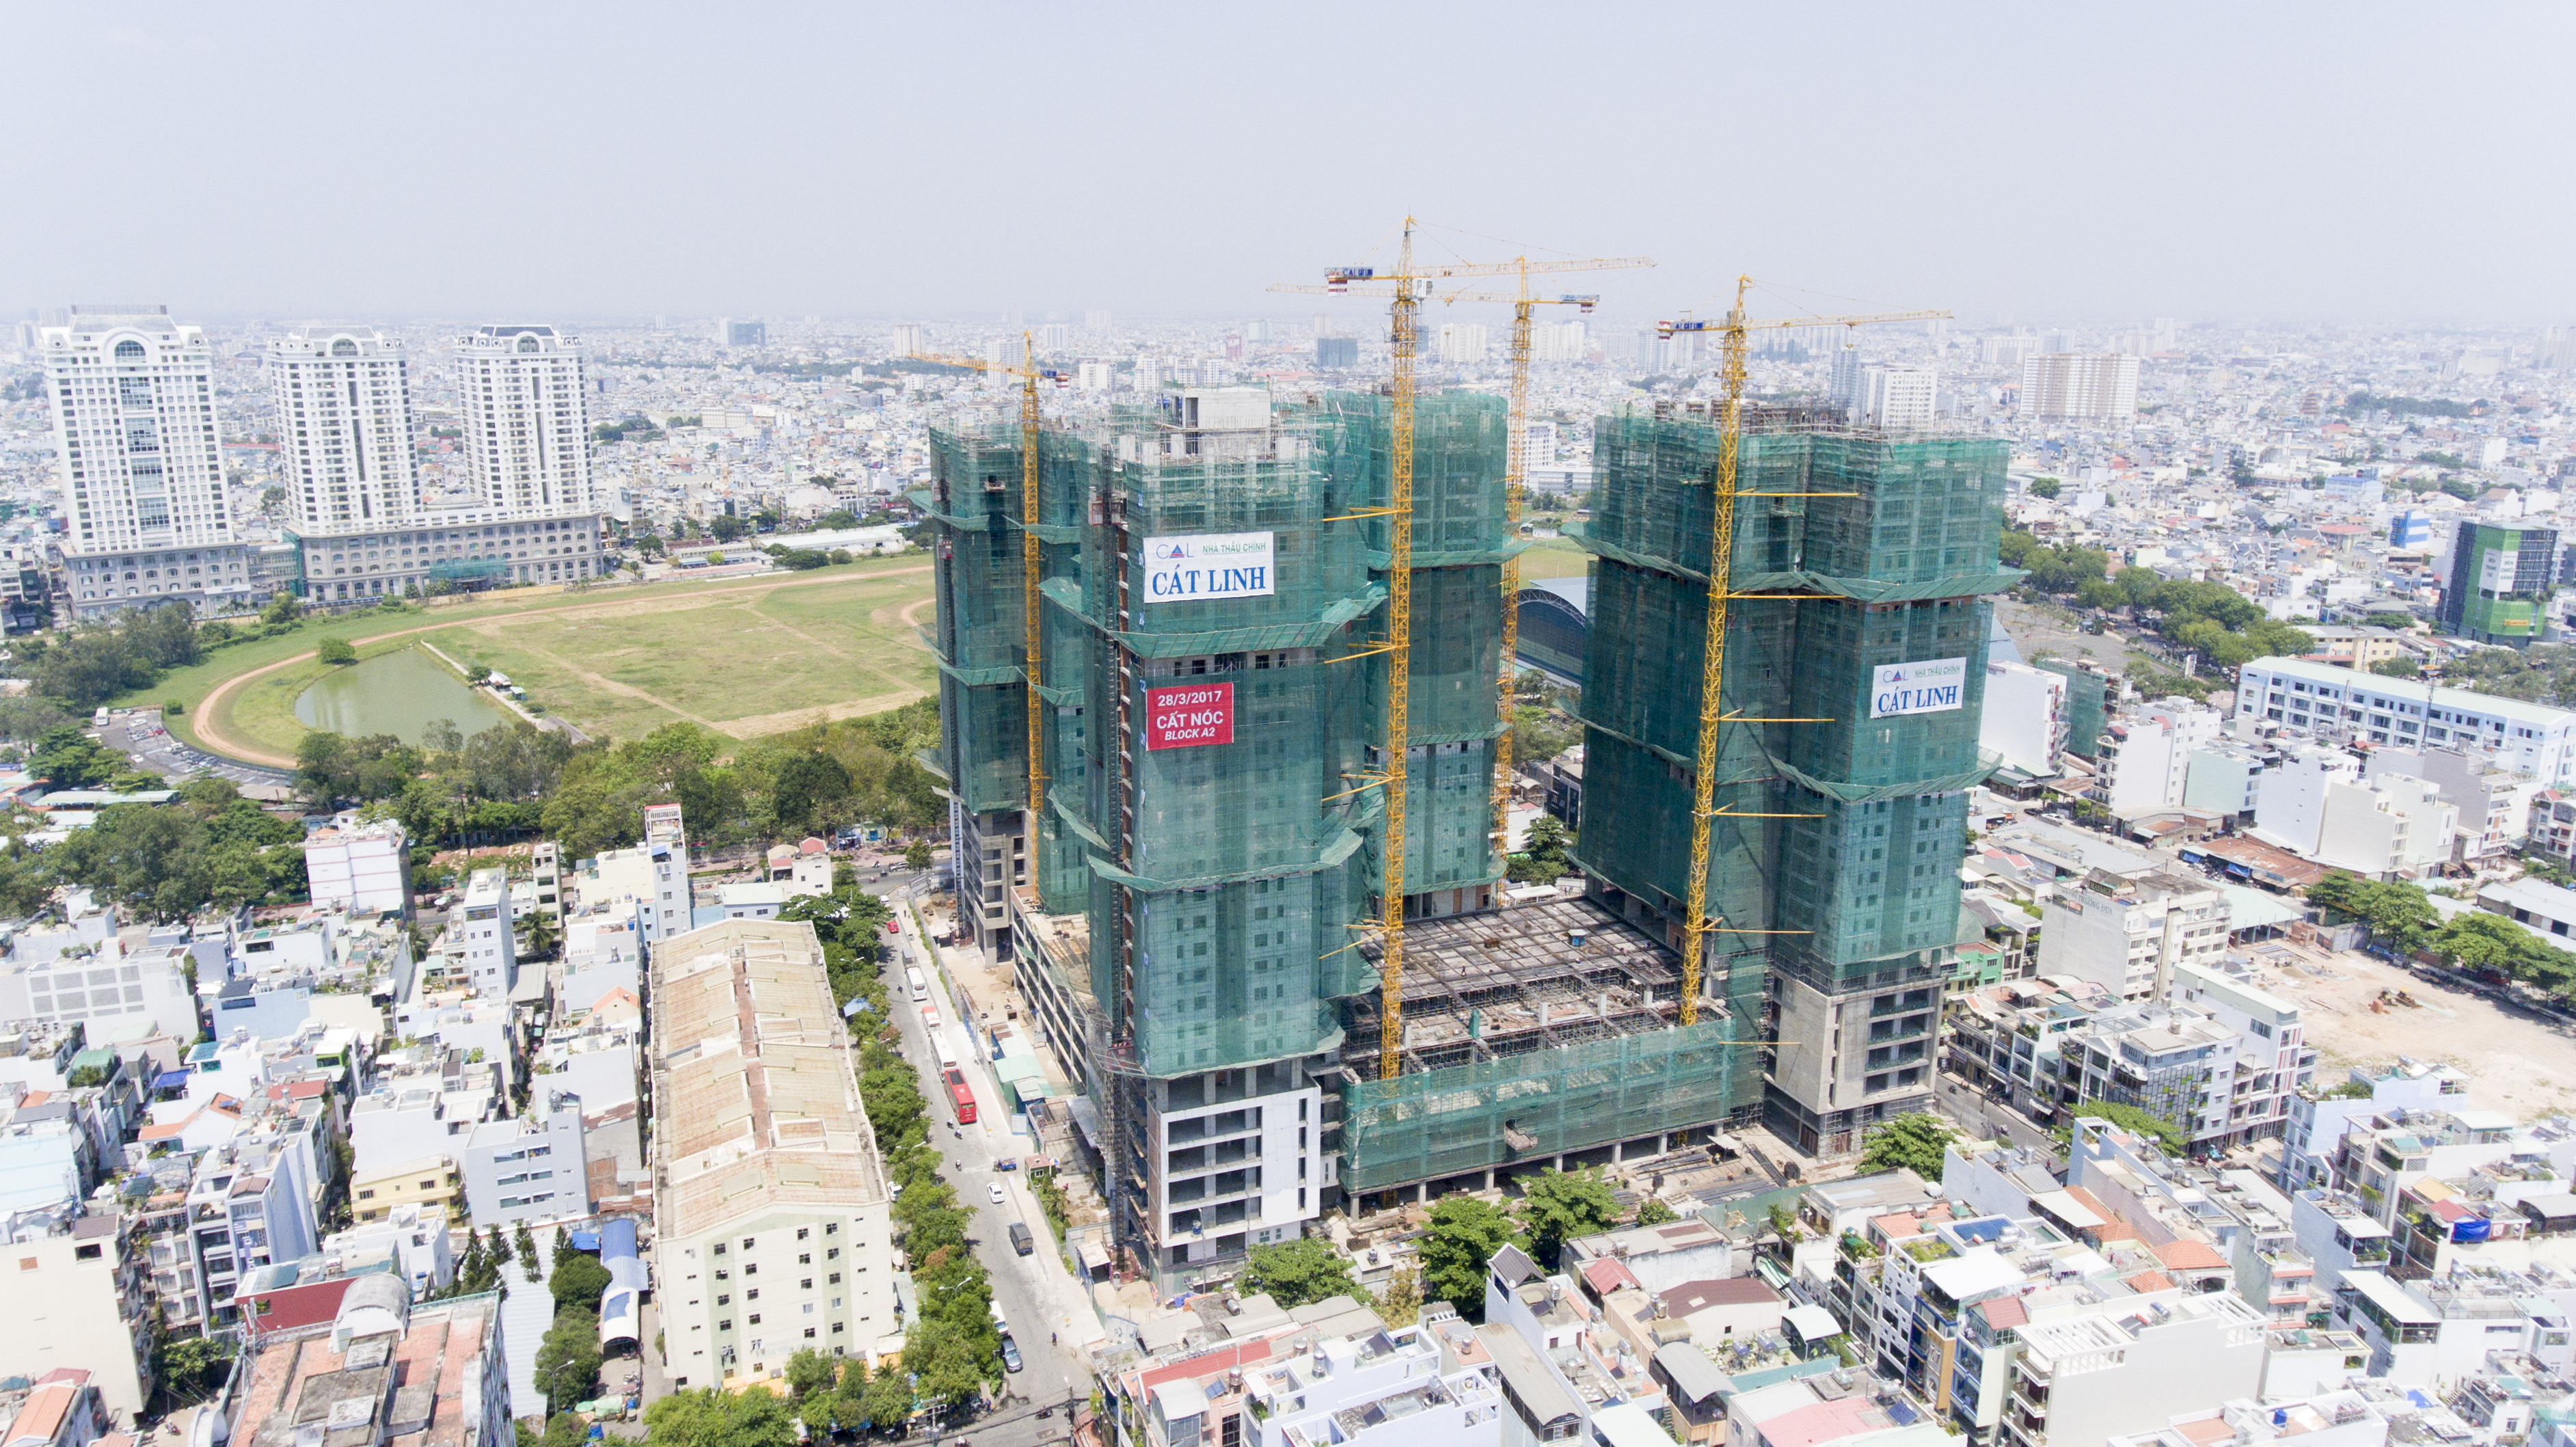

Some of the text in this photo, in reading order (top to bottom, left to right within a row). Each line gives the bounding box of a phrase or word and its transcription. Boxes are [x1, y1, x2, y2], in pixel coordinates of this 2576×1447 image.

[1203, 543, 1219, 553] NHÀ
[1243, 540, 1266, 552] CHÍNH
[1152, 564, 1266, 595] CÁT LINH
[1158, 690, 1222, 707] 28/3/2017
[1878, 685, 1958, 712] CÁT LINH
[1156, 708, 1223, 729] CẤT NÓC
[1165, 727, 1215, 741] BLOCK A2
[2090, 880, 2113, 897] MASSAGE
